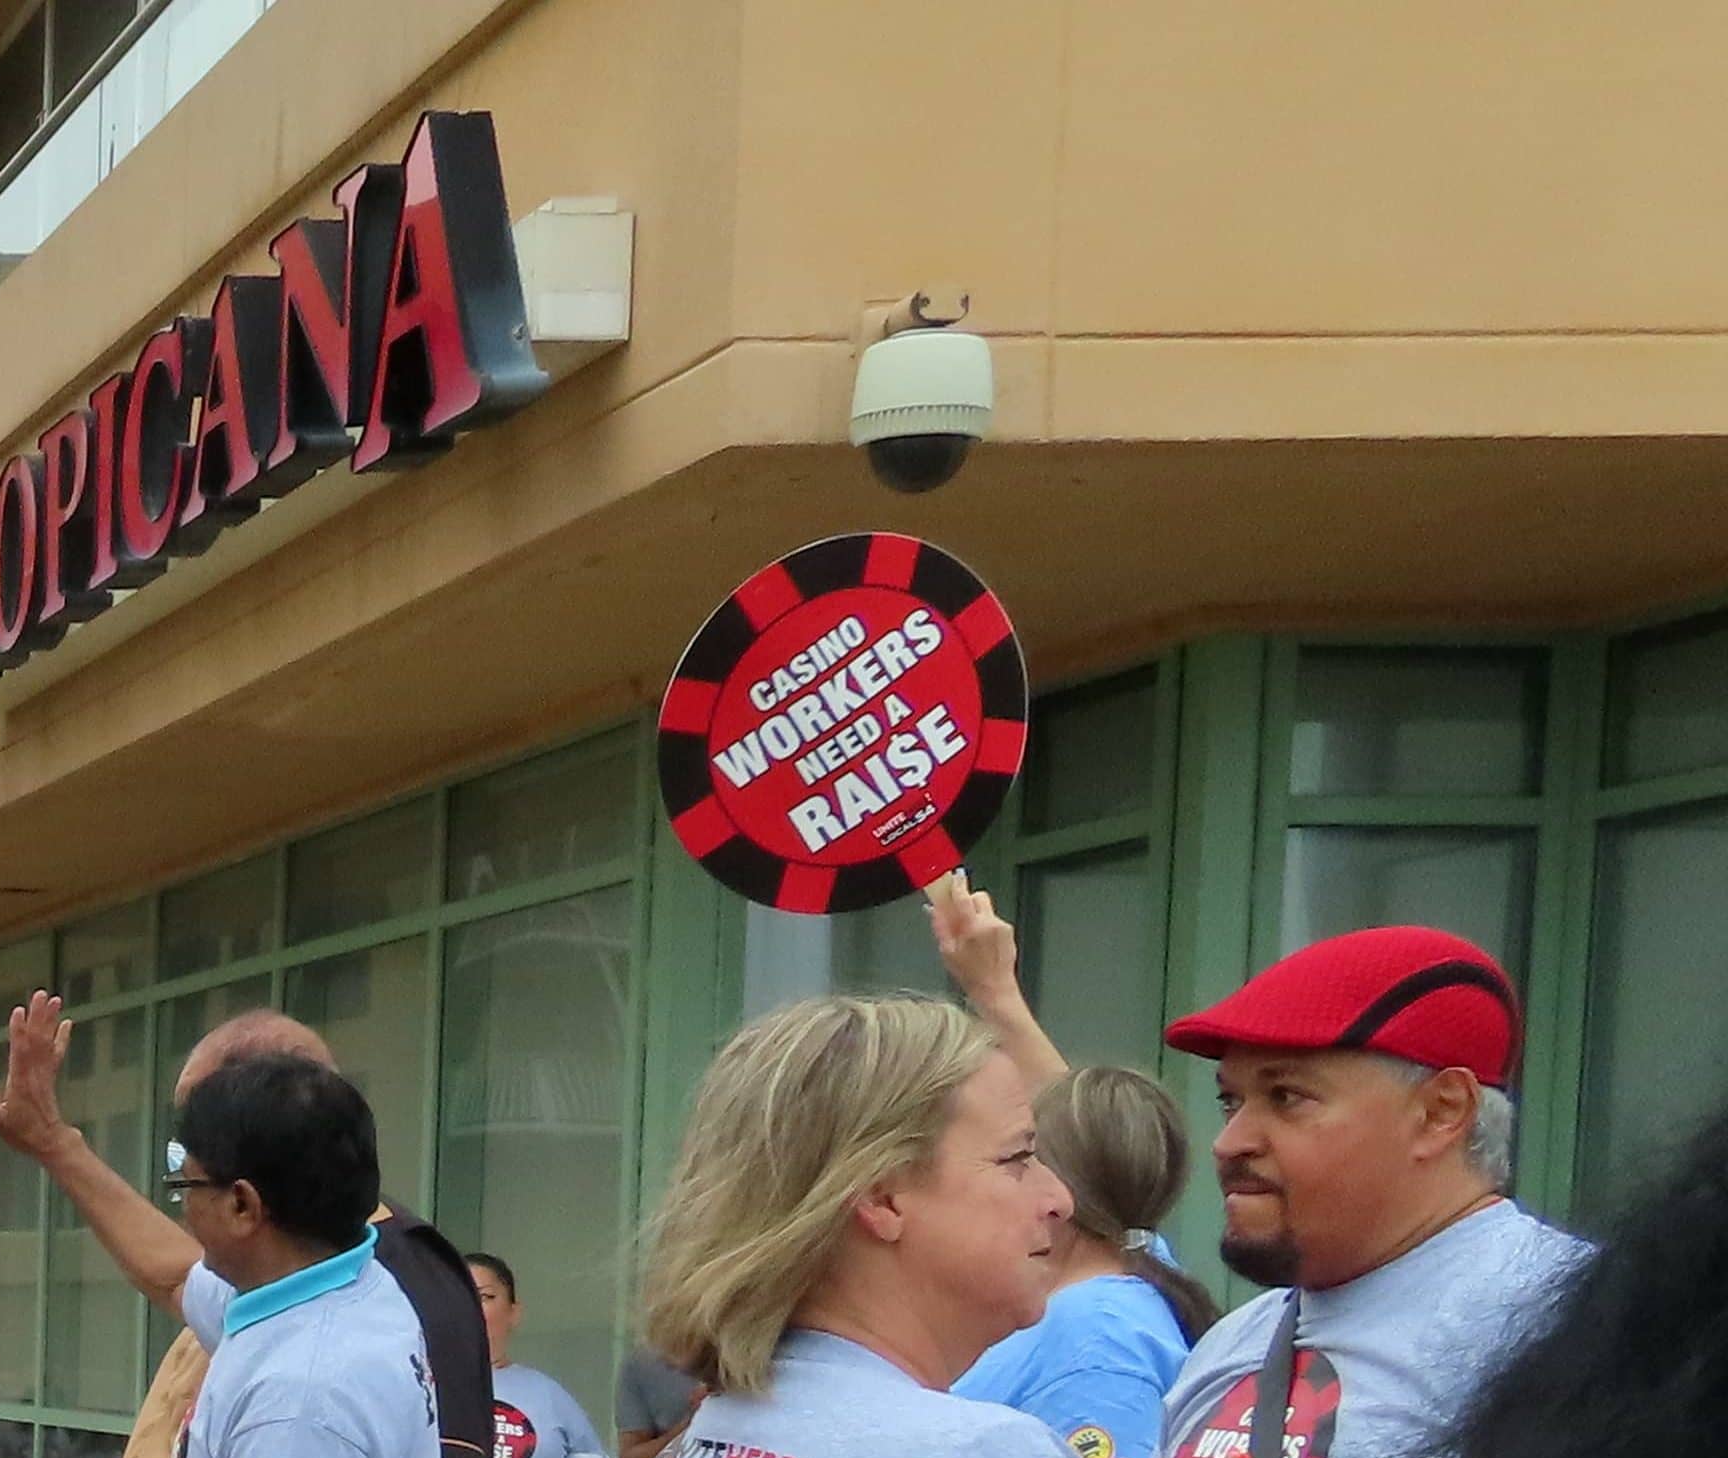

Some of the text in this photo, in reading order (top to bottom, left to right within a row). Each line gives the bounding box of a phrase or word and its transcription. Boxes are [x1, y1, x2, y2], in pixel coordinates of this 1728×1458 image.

[711, 608, 943, 789] WORKERS
[748, 615, 867, 713] CASINO
[787, 703, 968, 853] RAI$E
[794, 693, 913, 786] NEED A
